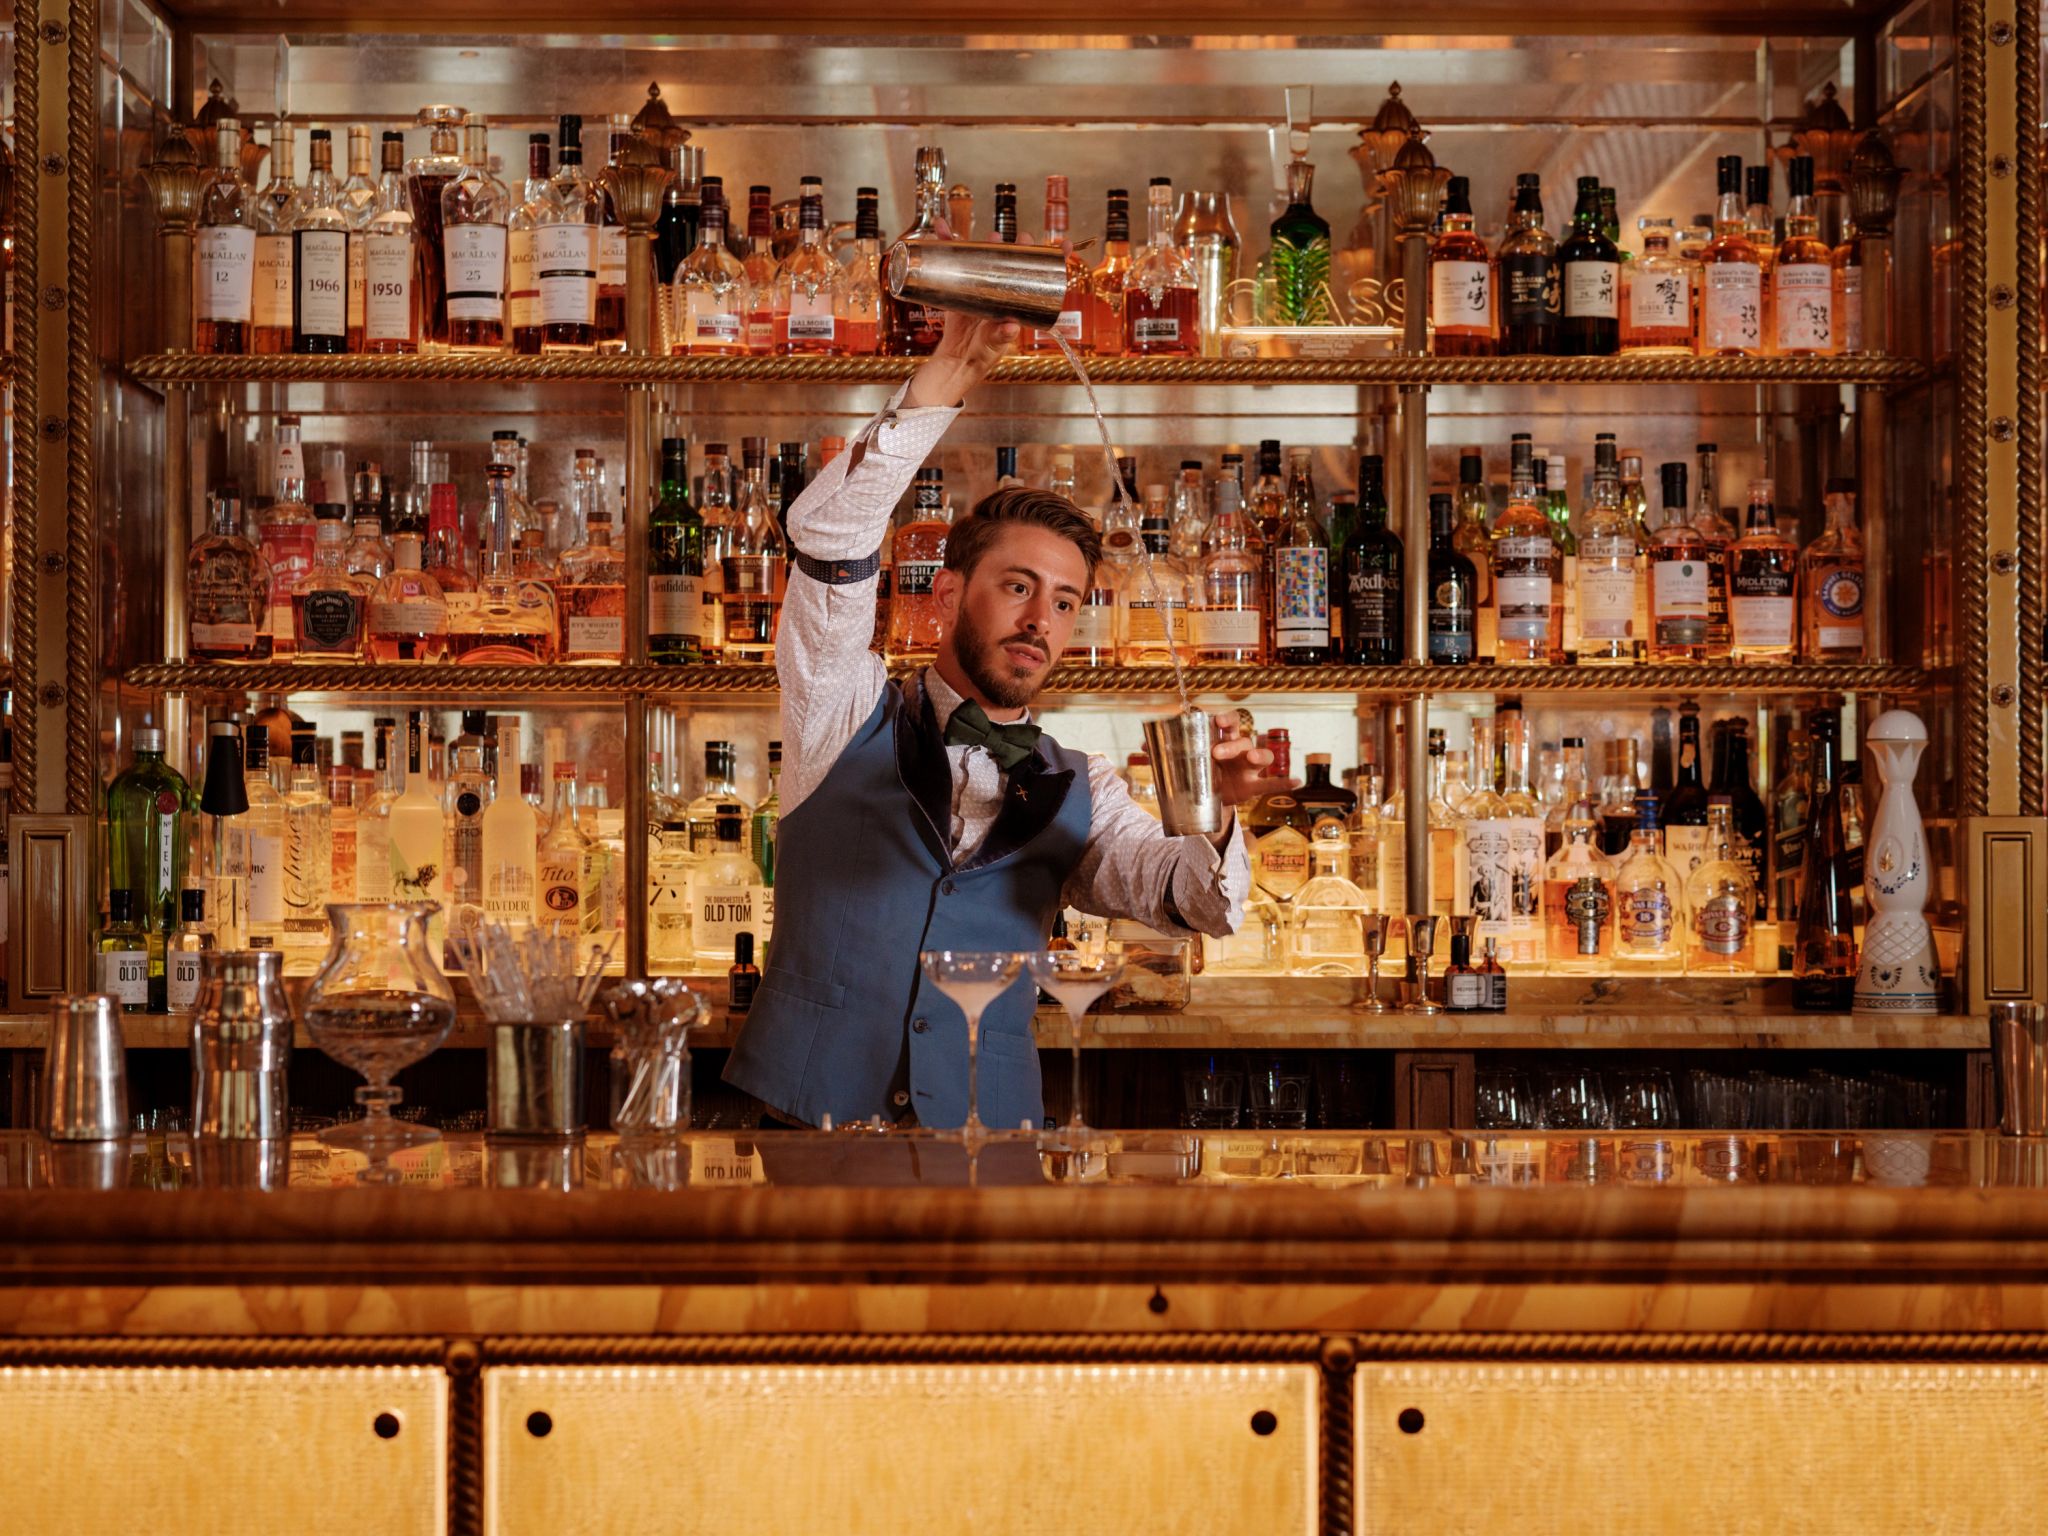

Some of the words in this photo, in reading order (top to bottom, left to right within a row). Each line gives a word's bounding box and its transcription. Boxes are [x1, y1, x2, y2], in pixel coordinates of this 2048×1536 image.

[200, 251, 246, 260] MACALLAN
[451, 251, 497, 259] MACALLAN
[542, 250, 587, 259] MACALLAN
[215, 271, 229, 282] 12
[466, 270, 481, 281] 25
[274, 279, 288, 289] 12
[309, 279, 340, 292] 1966
[372, 283, 403, 296] 1950
[899, 576, 926, 585] PARK
[1737, 576, 1788, 587] MIDLETON
[1173, 617, 1184, 628] 12
[704, 904, 725, 922] OLD
[728, 904, 752, 922] TOM
[119, 967, 137, 982] OLD
[176, 967, 195, 982] OLD
